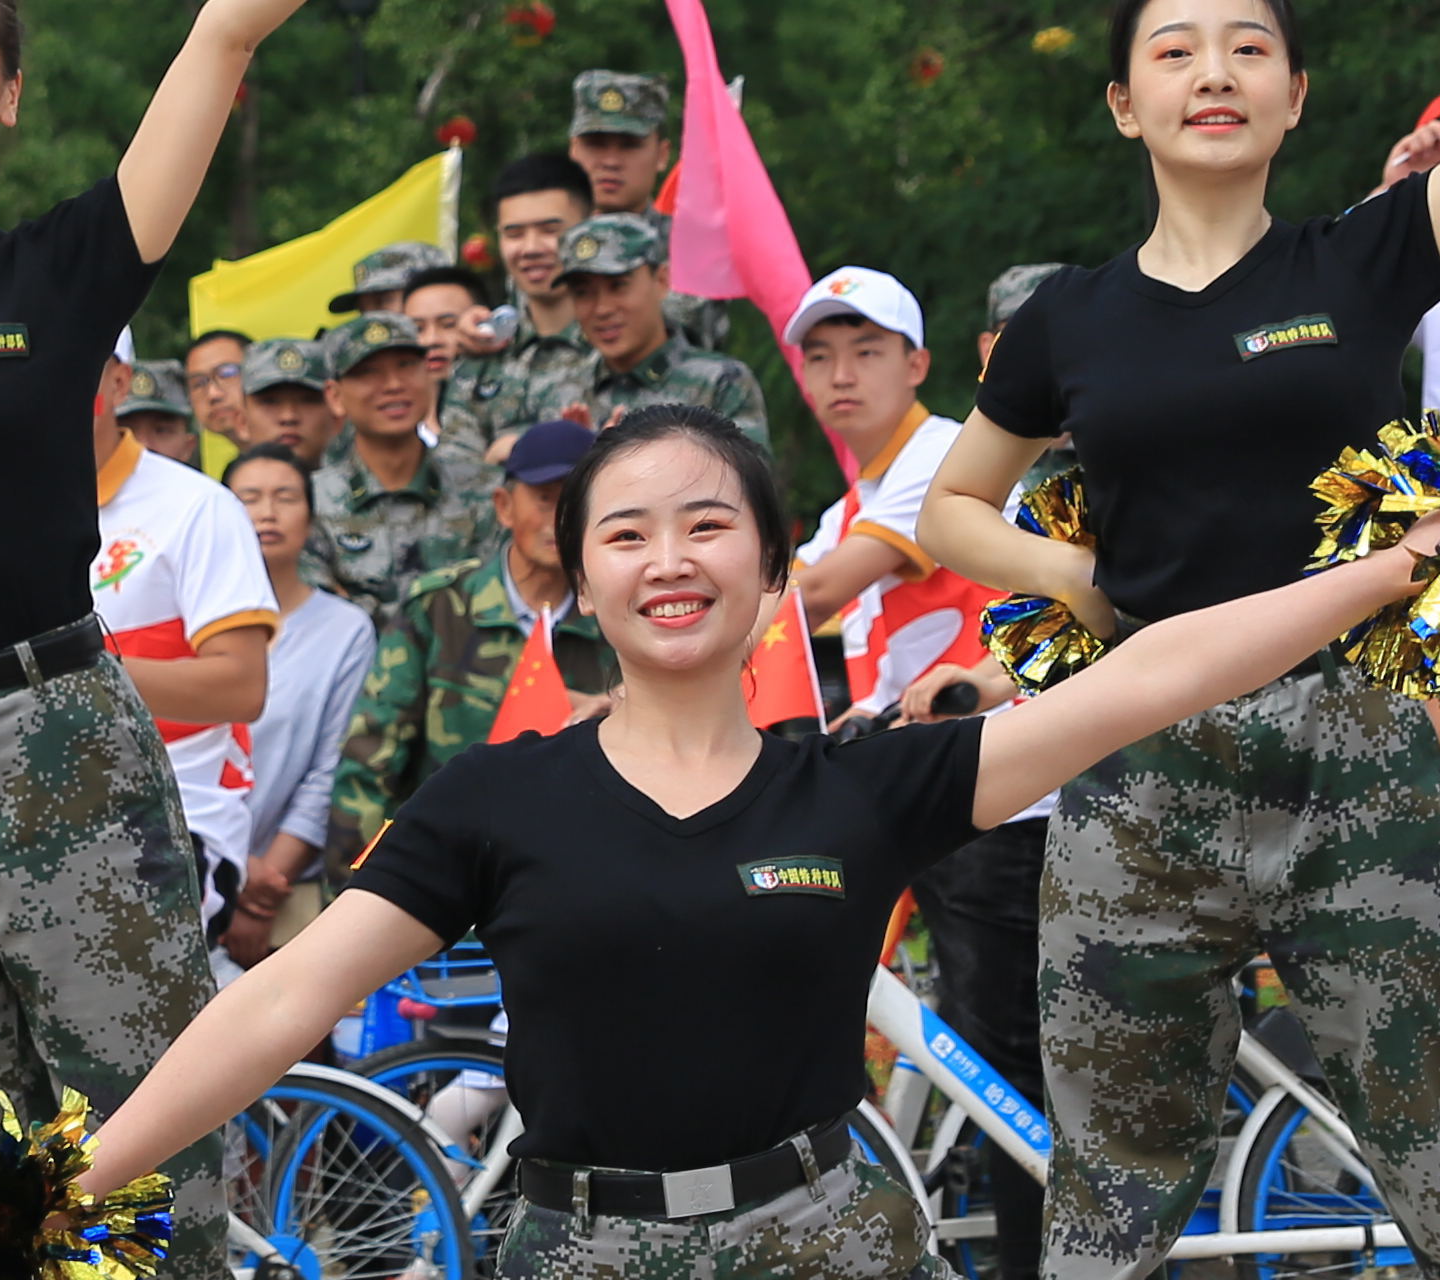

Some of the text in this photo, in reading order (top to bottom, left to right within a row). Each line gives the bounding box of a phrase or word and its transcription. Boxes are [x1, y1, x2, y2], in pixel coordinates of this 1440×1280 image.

[1267, 322, 1333, 345] 中国特种部队
[777, 867, 842, 888] 中国特种部队
[983, 1081, 1049, 1143] 哈罗单车
